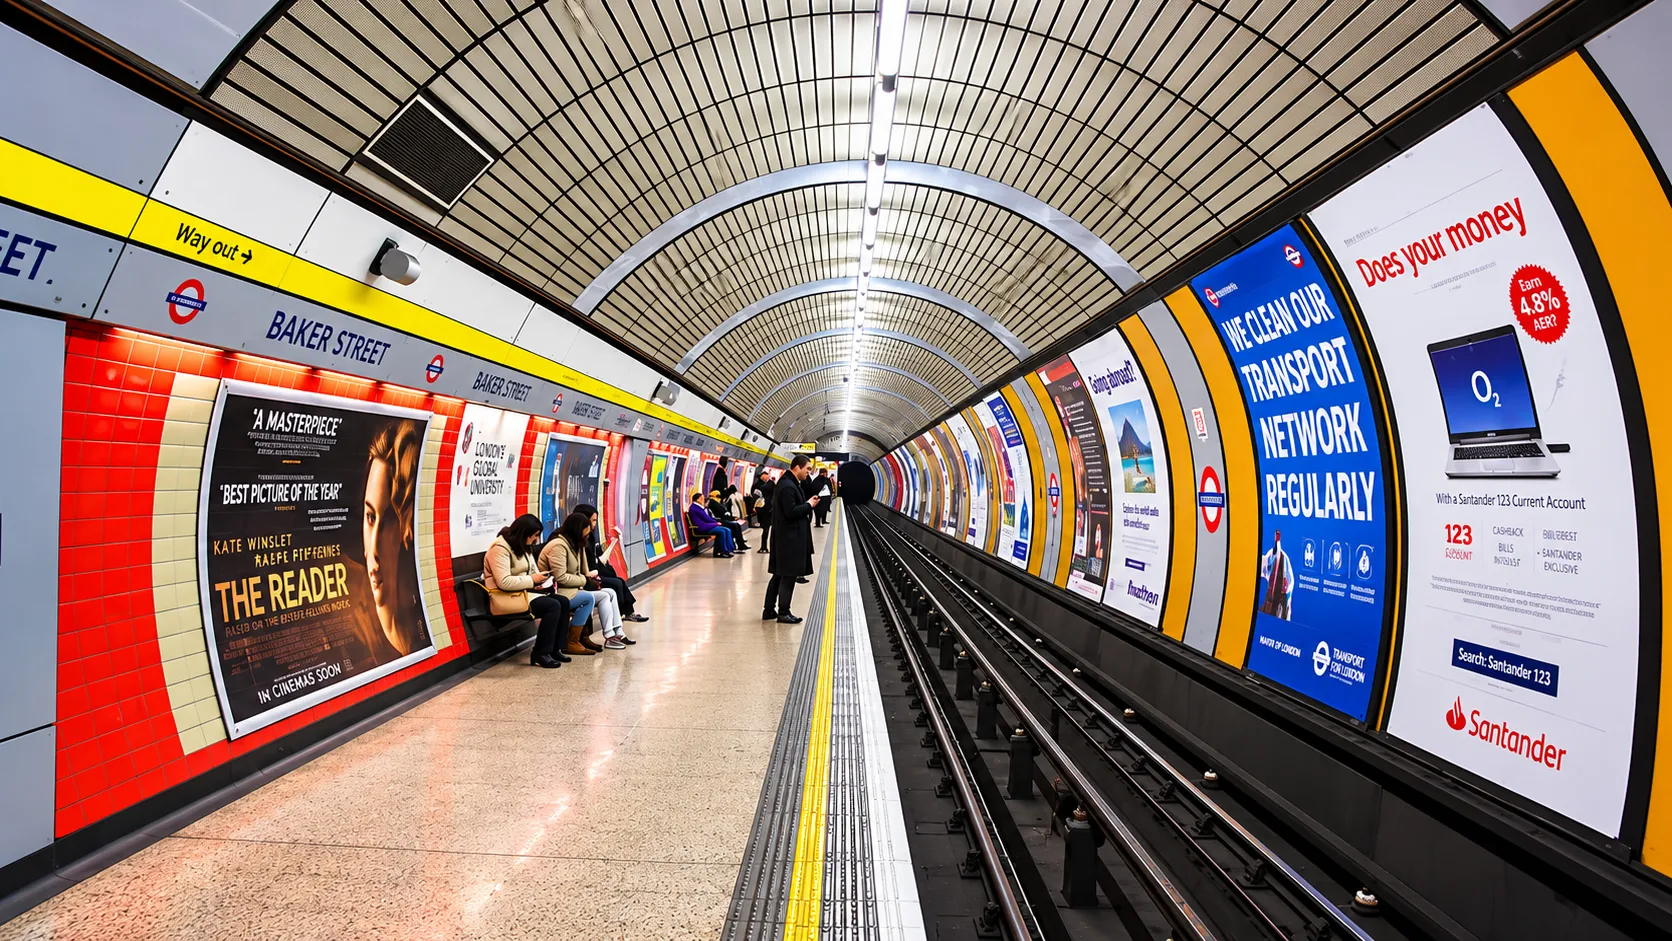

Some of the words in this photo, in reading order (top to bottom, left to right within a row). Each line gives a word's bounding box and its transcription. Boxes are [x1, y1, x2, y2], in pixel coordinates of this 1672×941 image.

[175, 221, 211, 254] Way
[212, 237, 240, 262] out
[1355, 251, 1405, 288] Does
[1400, 231, 1446, 278] your
[1445, 197, 1527, 252] money
[1518, 276, 1542, 293] Earn
[1221, 315, 1254, 353] WE
[1245, 296, 1298, 345] CLEAN
[1289, 282, 1335, 328] OUR
[1519, 288, 1561, 317] 4.8%
[266, 310, 332, 353] BAKER
[332, 330, 392, 366] STREET
[1533, 315, 1557, 332] AER?
[472, 371, 505, 396] BAKER
[502, 380, 533, 402] STREET
[1241, 336, 1355, 403] TRANSPORT
[1259, 401, 1368, 459] NETWORK
[250, 483, 289, 504] PICTURE
[290, 483, 302, 502] OF
[304, 483, 319, 501] THE
[1265, 471, 1376, 522] REGULARLY
[1435, 493, 1452, 504] With
[1452, 496, 1458, 505] a
[1458, 494, 1496, 507] Santander
[1497, 495, 1510, 507] 123
[1512, 495, 1545, 509] Current
[1546, 496, 1586, 510] Account
[213, 538, 242, 556] KATE
[247, 533, 292, 551] WINSLET
[1445, 523, 1473, 546] 123
[1498, 542, 1514, 554] BILLS
[1542, 548, 1583, 562] SANTANDER
[1544, 561, 1579, 575] EXCLUSIVE
[214, 575, 265, 623] THE
[268, 562, 349, 612] READER
[257, 690, 271, 704] IN
[273, 673, 315, 698] CINEMAS
[316, 662, 342, 685] SOON
[1457, 647, 1487, 667] Search:
[1487, 655, 1532, 681] Santander
[1533, 668, 1551, 686] 123
[1468, 709, 1567, 771] Santander
